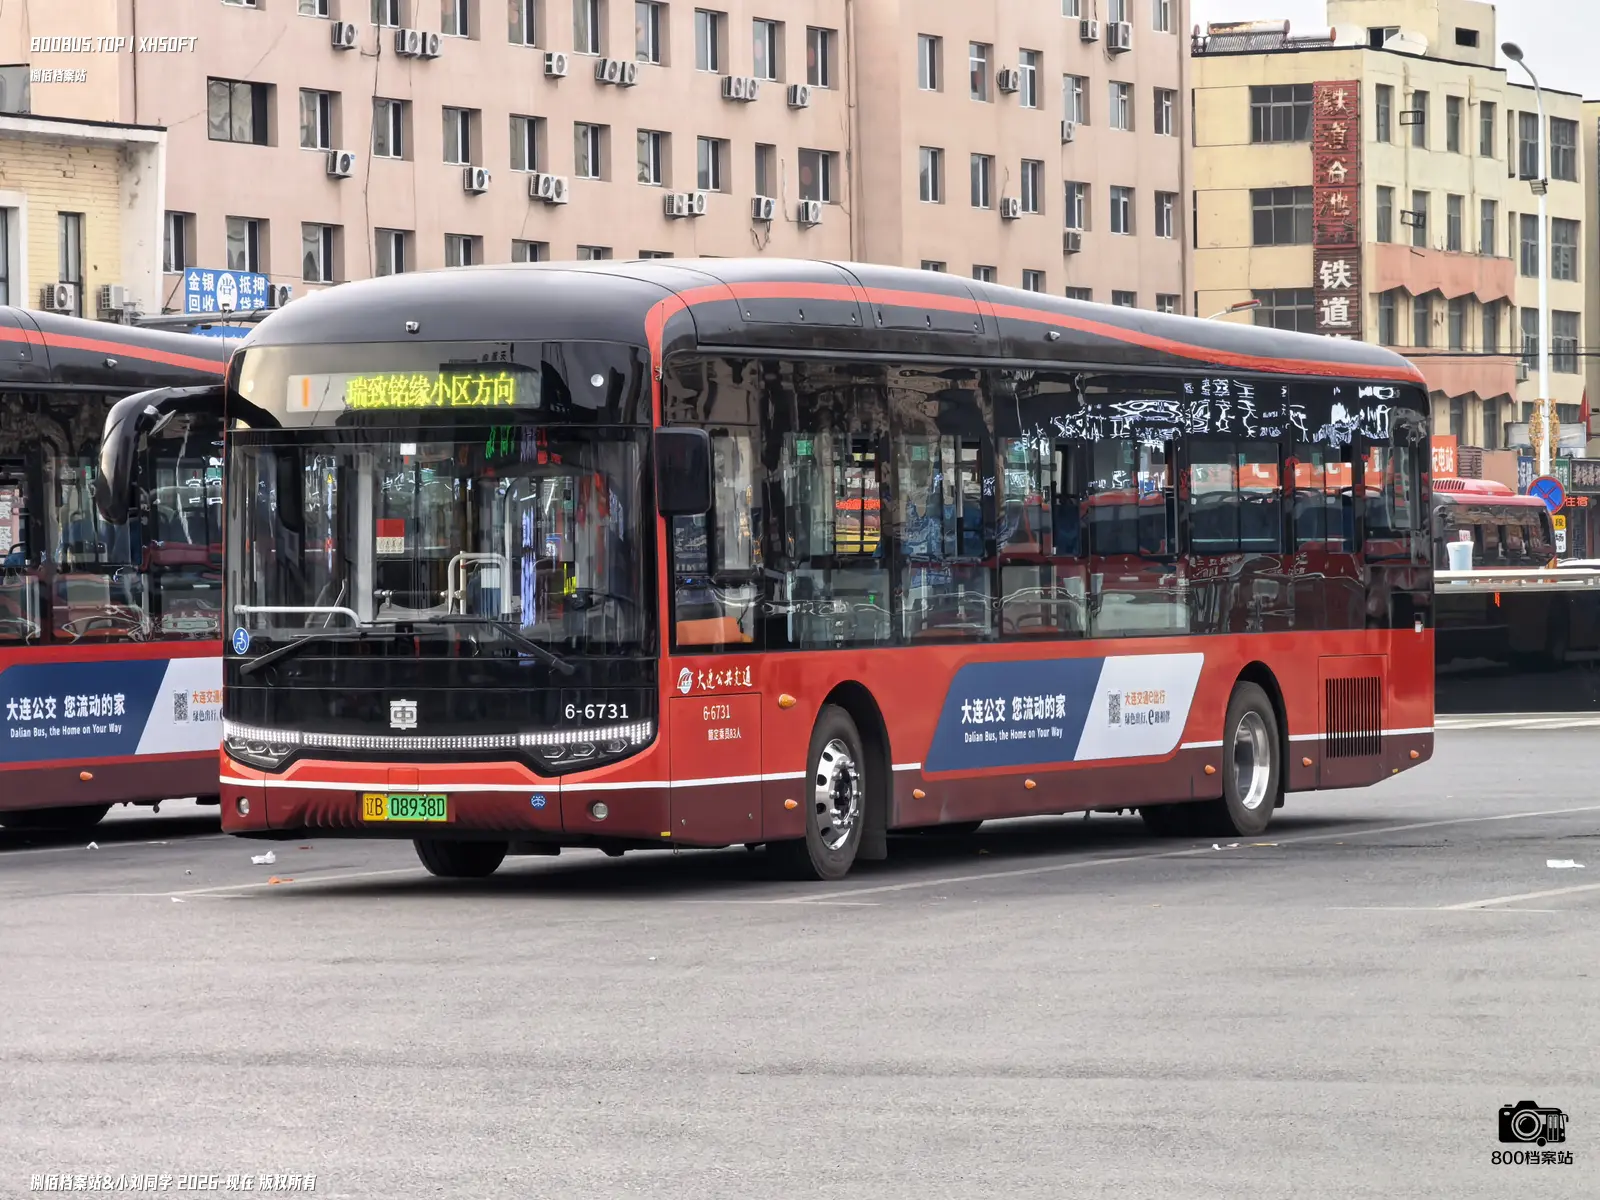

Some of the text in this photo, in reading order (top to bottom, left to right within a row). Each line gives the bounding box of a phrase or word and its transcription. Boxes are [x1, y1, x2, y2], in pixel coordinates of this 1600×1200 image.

[188, 272, 214, 291] 金银
[239, 275, 265, 295] 抵押
[188, 294, 214, 312] 回收
[697, 665, 752, 690] 大连公共交通
[6, 693, 126, 721] 大连公交 您流动的家
[565, 703, 629, 719] 6-6731
[703, 704, 730, 720] 6-6731
[961, 694, 1066, 725] 大连公交 您流动的家
[10, 723, 122, 739] Dalian Bus, the Home on Your Way
[964, 727, 1063, 743] Dalian Bus, the Home on Your Way
